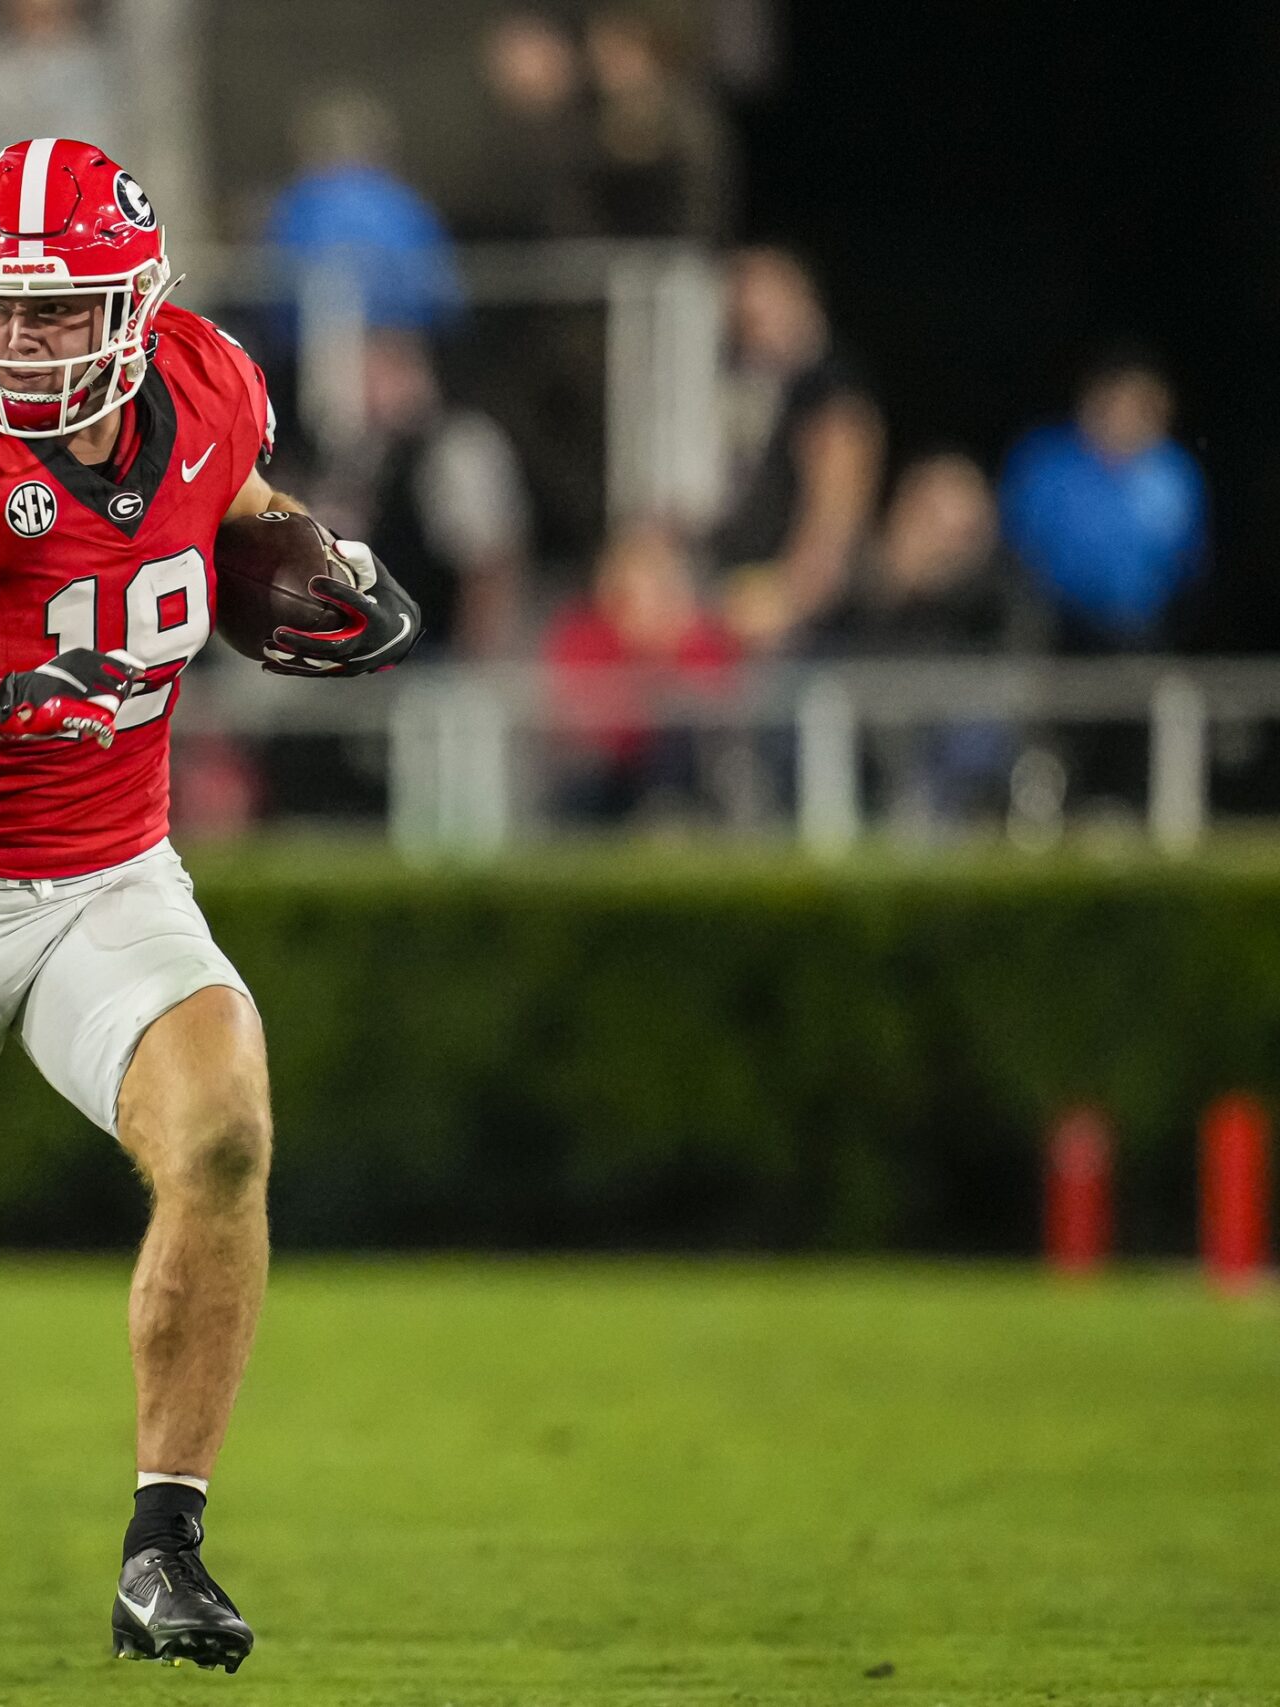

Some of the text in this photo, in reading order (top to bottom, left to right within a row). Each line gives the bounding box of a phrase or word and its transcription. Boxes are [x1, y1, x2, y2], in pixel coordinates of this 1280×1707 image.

[2, 263, 56, 275] DAWGS
[9, 484, 54, 534] SEC
[44, 544, 211, 741] 19
